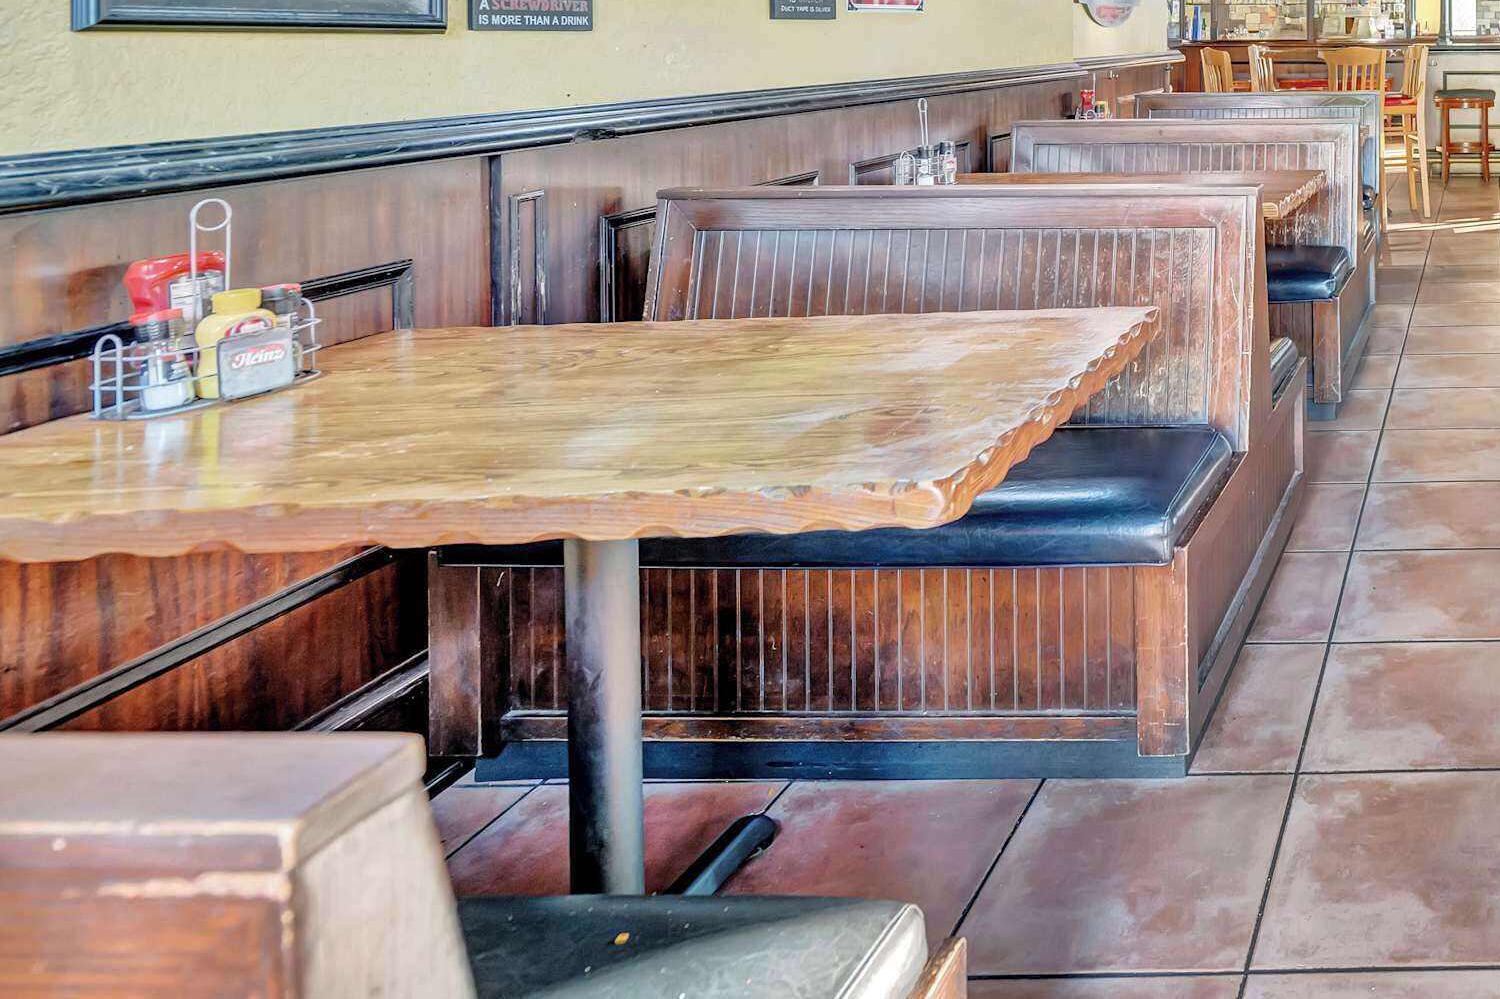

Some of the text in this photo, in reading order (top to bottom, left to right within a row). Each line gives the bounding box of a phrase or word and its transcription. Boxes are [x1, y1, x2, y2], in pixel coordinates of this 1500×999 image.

[478, 14, 590, 26] IS MORE THAN A DRINK
[230, 349, 285, 370] Heinz
